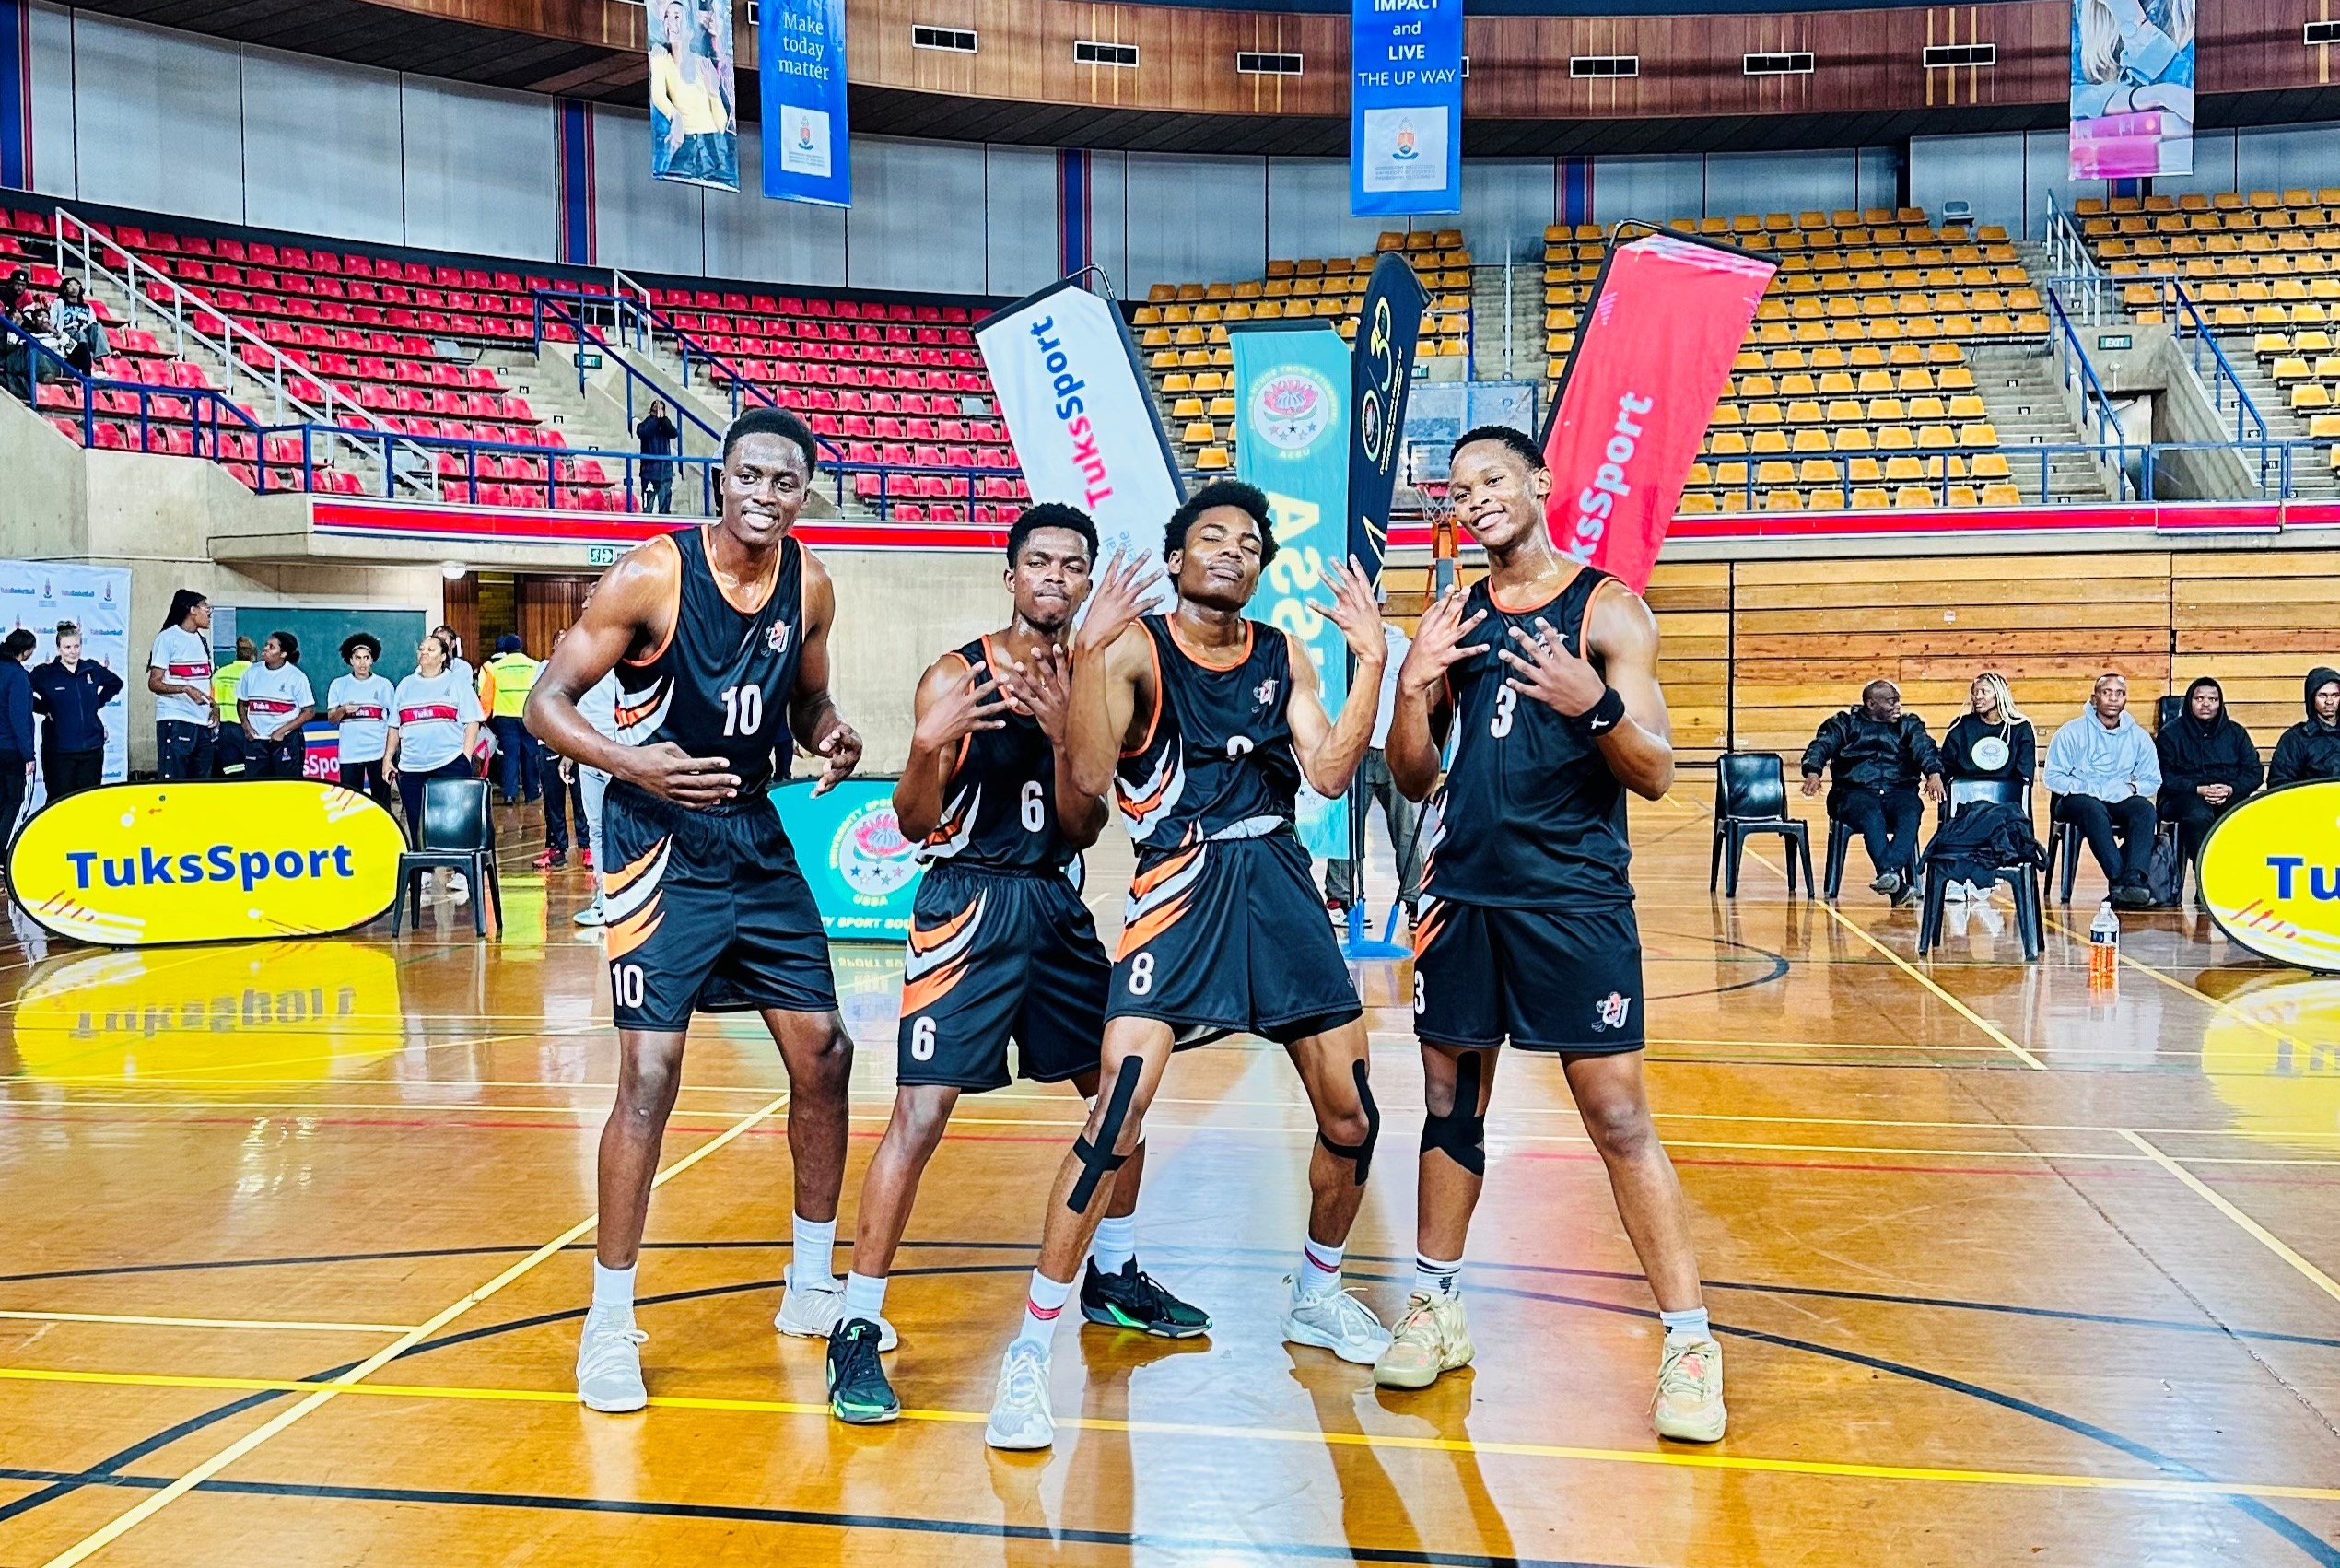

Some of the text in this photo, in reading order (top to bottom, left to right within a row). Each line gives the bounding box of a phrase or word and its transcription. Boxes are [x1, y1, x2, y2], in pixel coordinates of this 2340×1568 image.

[783, 12, 824, 36] Make
[1392, 21, 1422, 35] and
[783, 34, 824, 62] today
[1388, 45, 1425, 61] LIVE
[778, 58, 830, 81] matter
[1358, 69, 1456, 87] THE UP WAY
[2105, 337, 2125, 347] EXIT
[1030, 315, 1114, 509] TuksSport
[1570, 392, 1653, 566] ksSport
[253, 702, 270, 710] Tuks
[354, 708, 370, 717] uks
[413, 708, 434, 720] Tuks
[720, 684, 763, 737] 10
[1489, 684, 1518, 740] 3
[303, 754, 340, 779] sSpo
[1021, 780, 1045, 833] 6
[65, 844, 356, 892] TuksSport
[2265, 856, 2340, 901] Tu
[837, 916, 883, 929] SPORT
[612, 962, 645, 1009] 10
[1128, 952, 1155, 997] 8
[1413, 969, 1425, 1015] 3
[910, 1015, 938, 1062] 6
